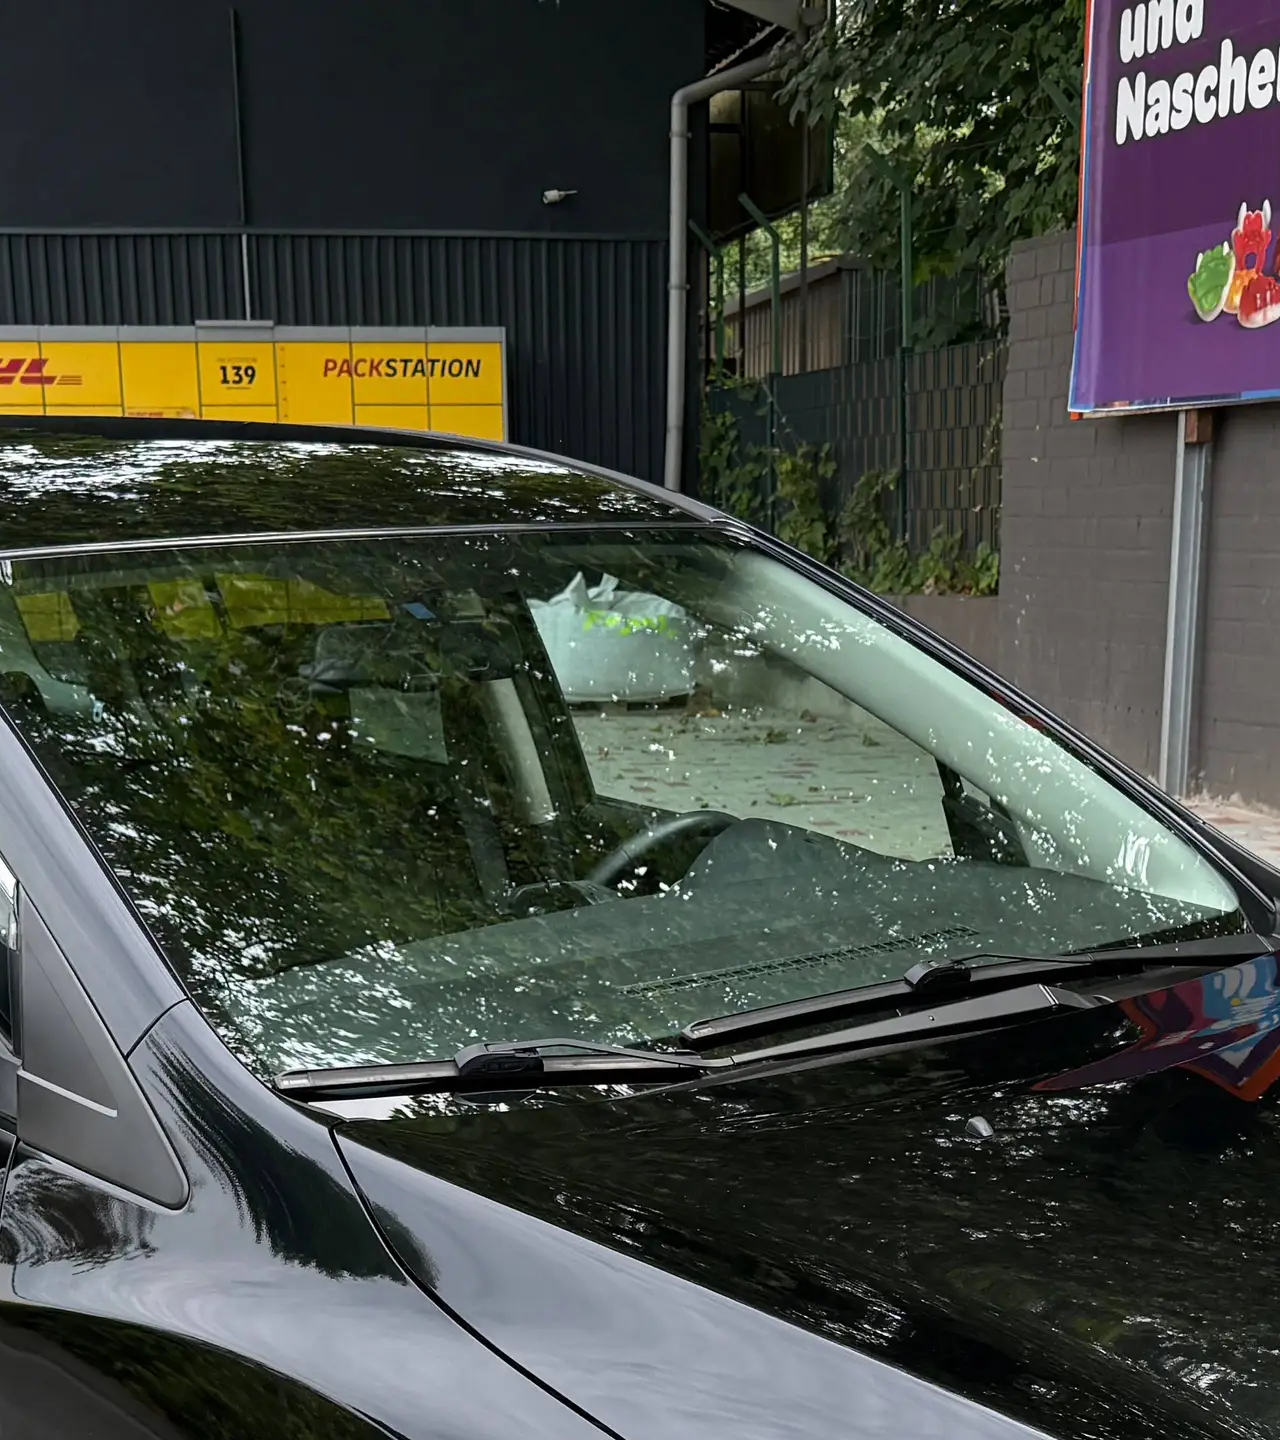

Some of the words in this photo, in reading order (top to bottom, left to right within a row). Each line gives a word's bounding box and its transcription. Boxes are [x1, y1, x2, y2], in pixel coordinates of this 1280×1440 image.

[1120, 0, 1204, 63] und
[219, 365, 257, 385] 139
[323, 358, 482, 378] PACKSTATION
